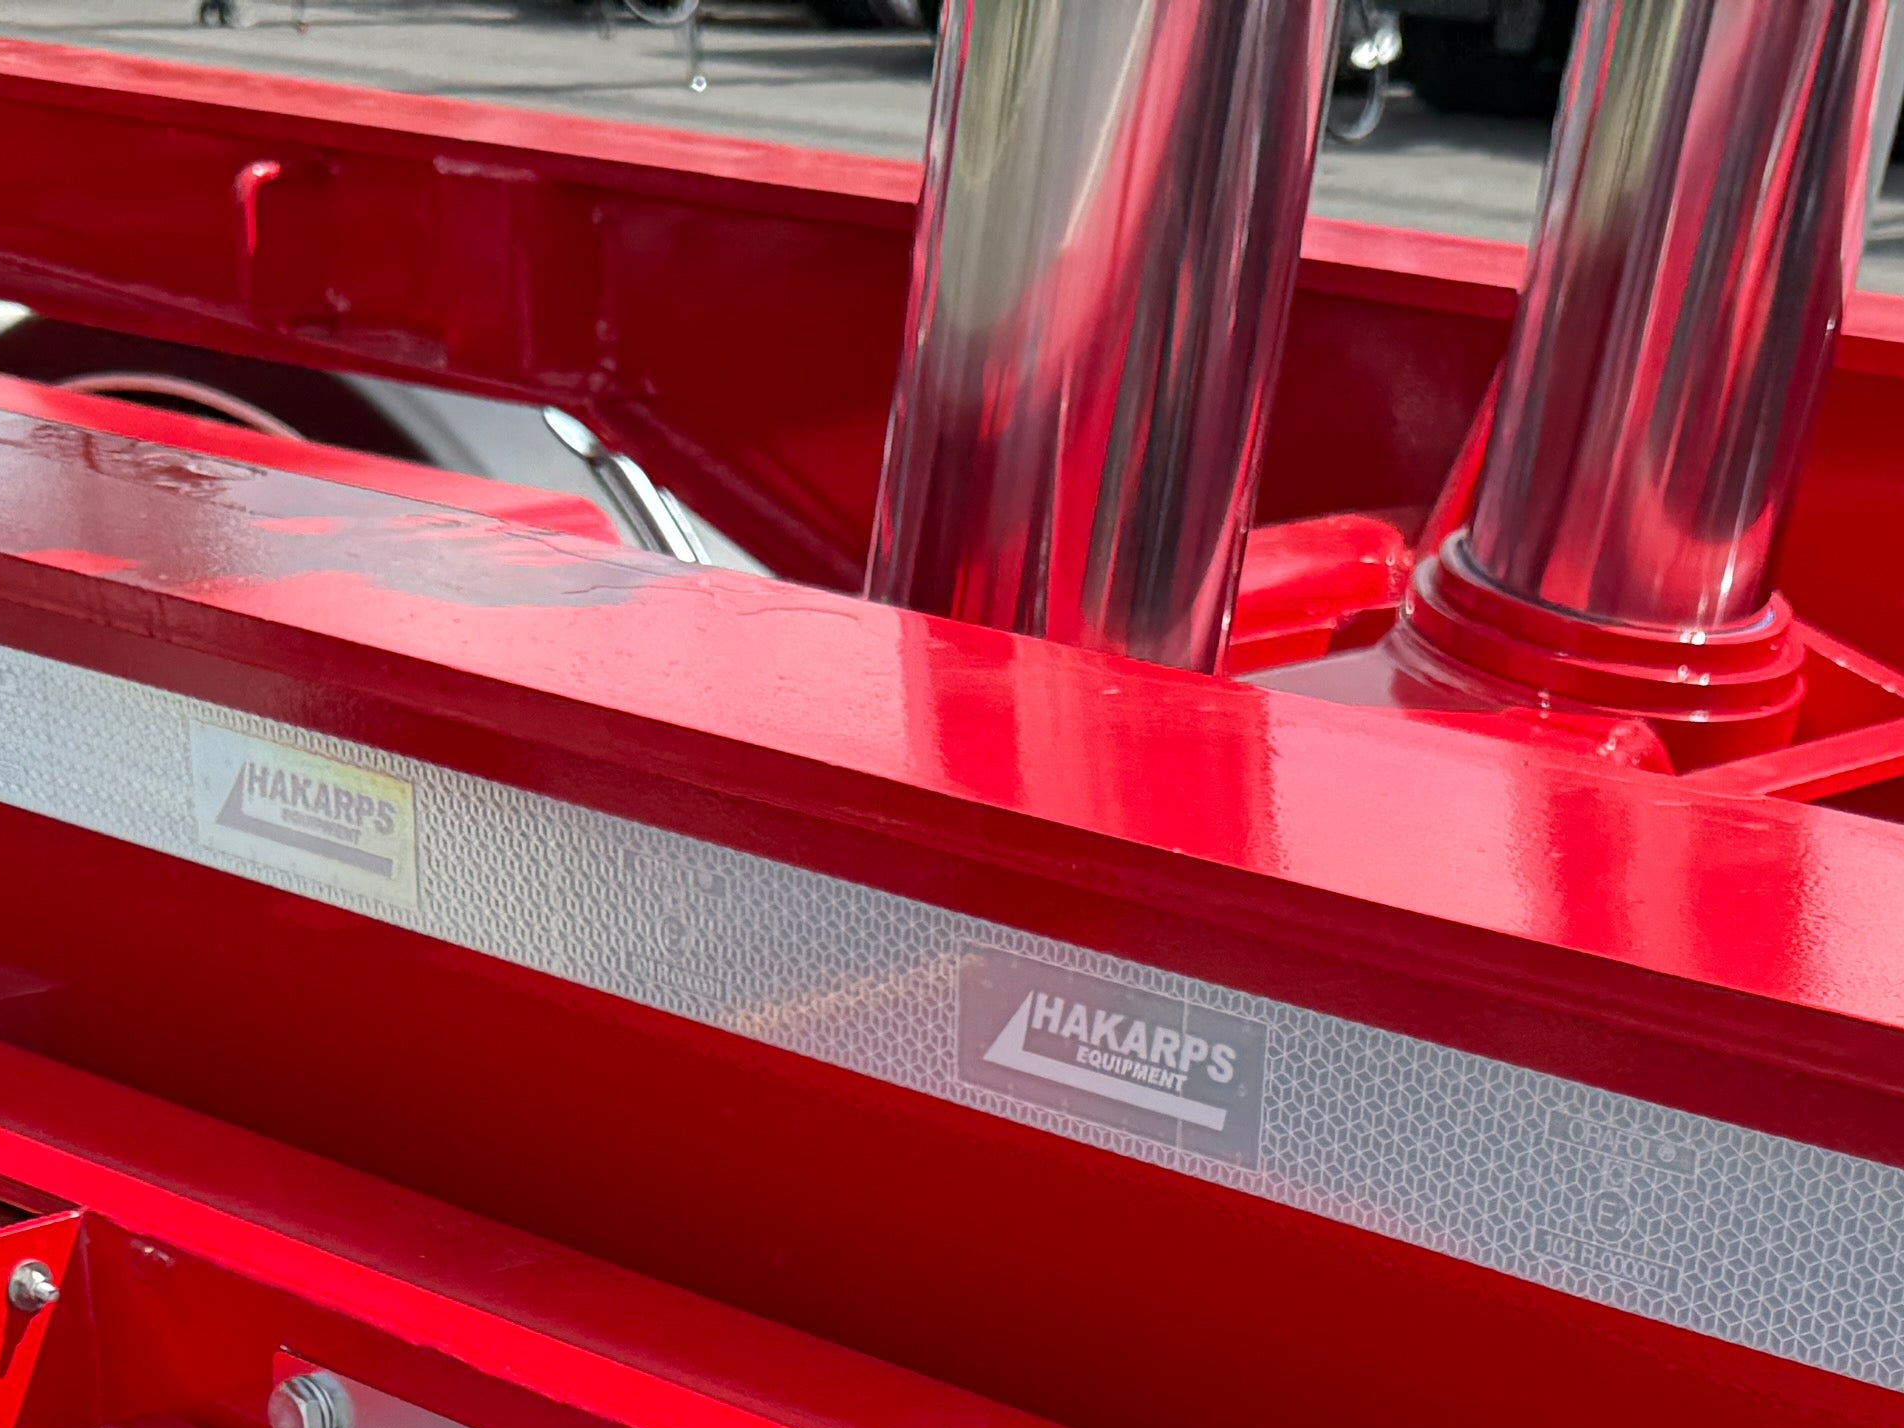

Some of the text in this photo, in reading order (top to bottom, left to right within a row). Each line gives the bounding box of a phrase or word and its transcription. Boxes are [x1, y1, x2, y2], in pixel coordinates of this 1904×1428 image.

[247, 762, 395, 836] HAKARPS
[1031, 992, 1236, 1084] HAKARPS
[1076, 1045, 1188, 1093] EQUIPMENT
[1569, 1119, 1657, 1164] ORAFOL
